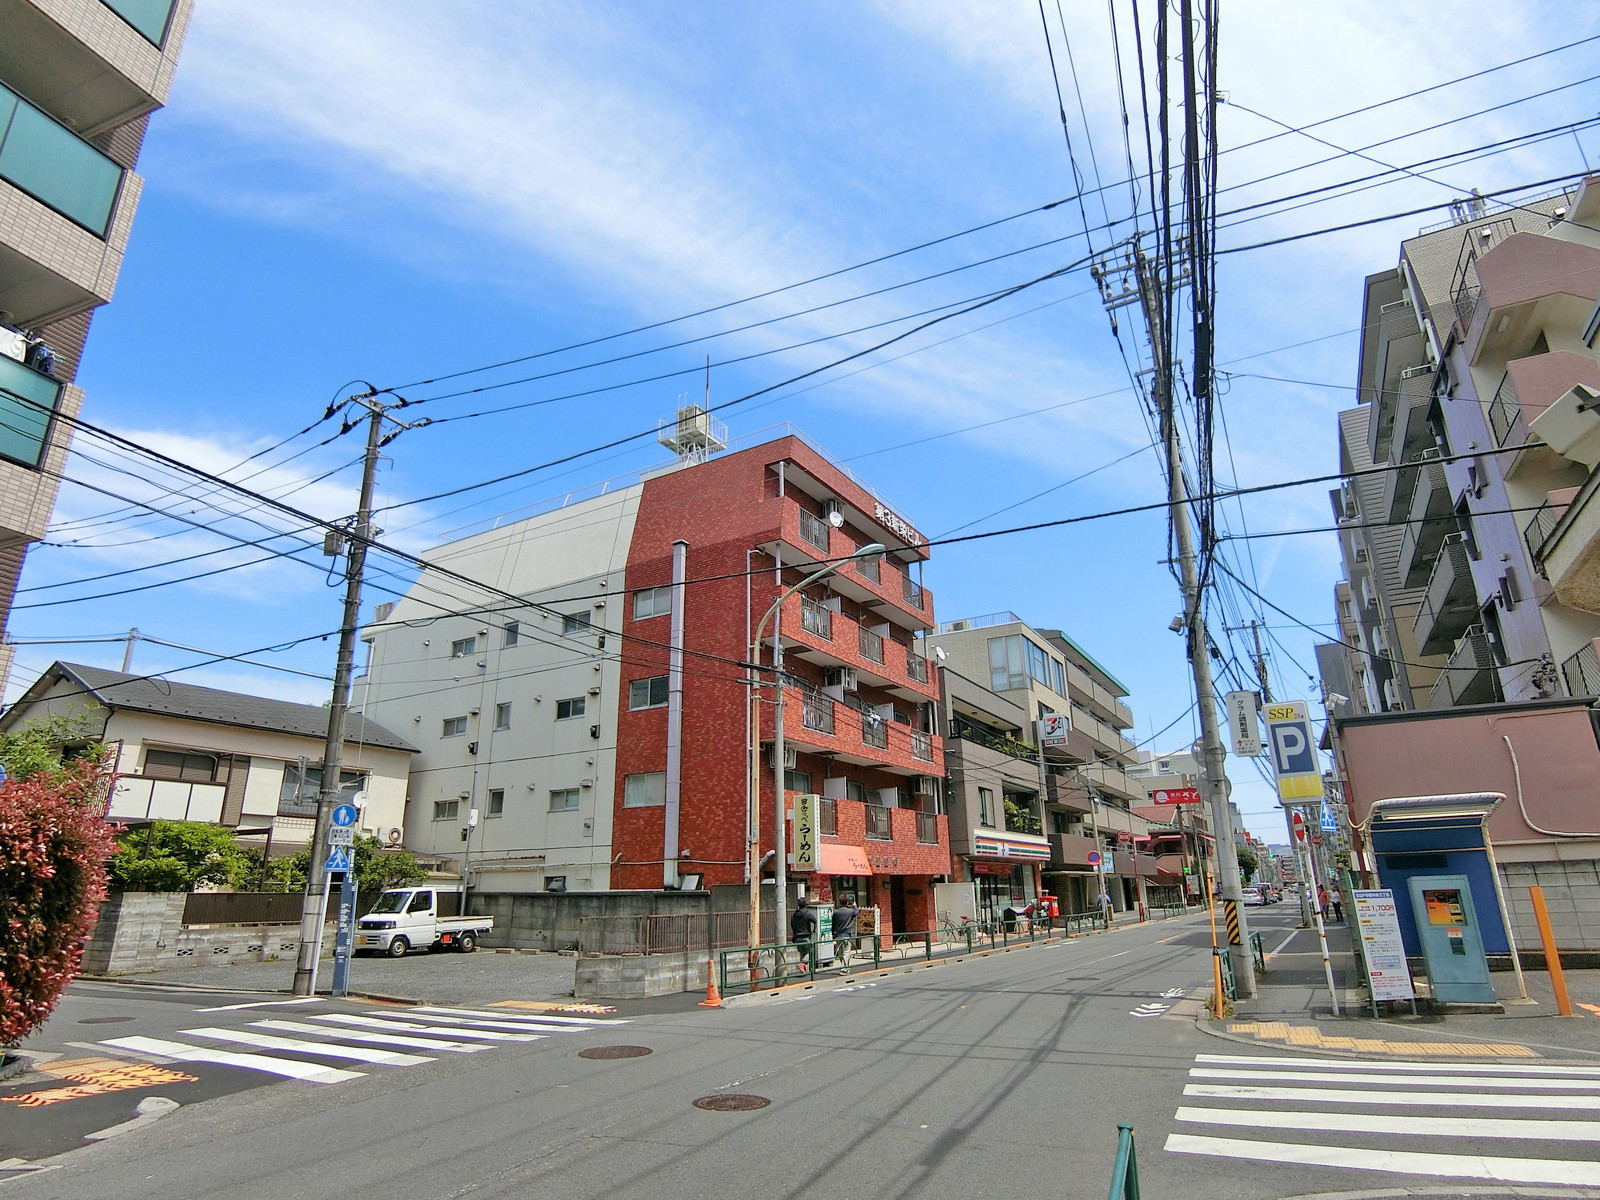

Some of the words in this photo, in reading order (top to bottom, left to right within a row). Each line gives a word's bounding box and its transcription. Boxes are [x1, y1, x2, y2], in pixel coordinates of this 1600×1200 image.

[1268, 707, 1293, 720] SSP
[1275, 726, 1306, 770] P
[1371, 904, 1394, 912] 1,700円
